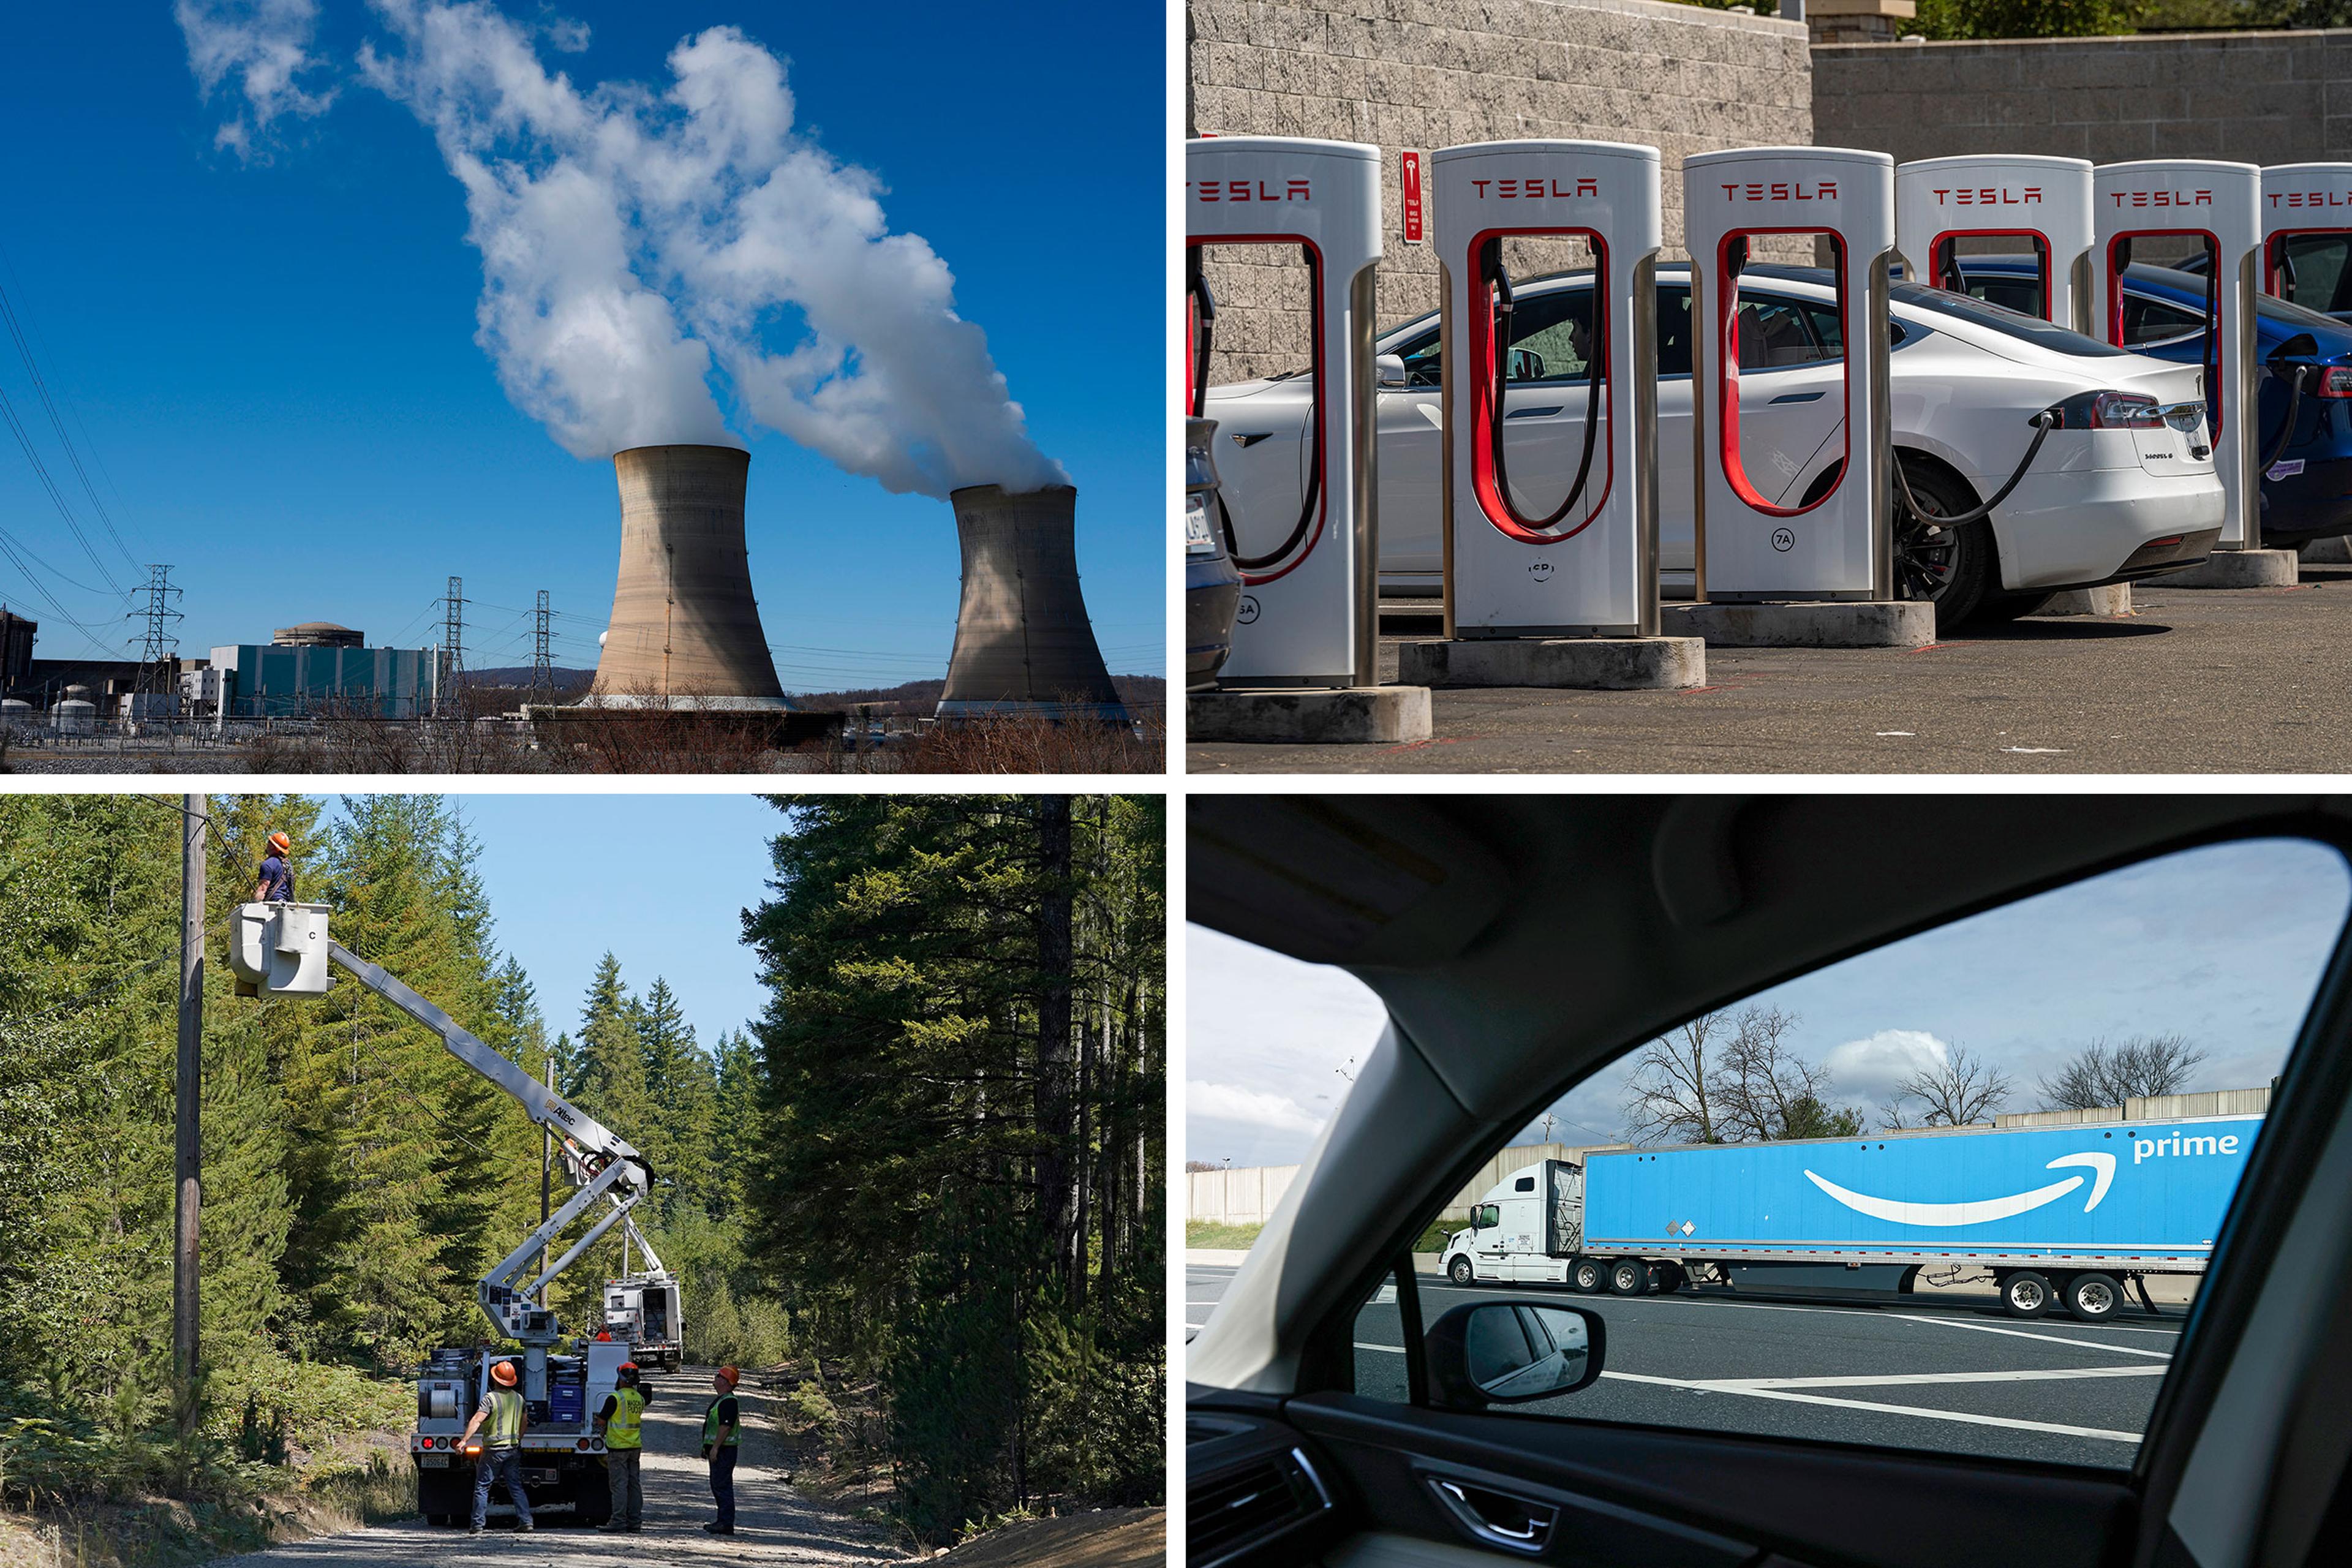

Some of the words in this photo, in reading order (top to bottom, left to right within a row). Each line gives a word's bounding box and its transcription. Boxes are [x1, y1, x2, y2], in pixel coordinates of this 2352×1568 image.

[1471, 179, 1597, 198] TESLA
[1721, 183, 1837, 201] TESLA
[1932, 188, 2041, 205] TESLA
[2110, 190, 2212, 208] TESLA
[1776, 535, 1791, 544] 7A
[553, 1107, 576, 1126] Altec
[2134, 1131, 2239, 1164] prime
